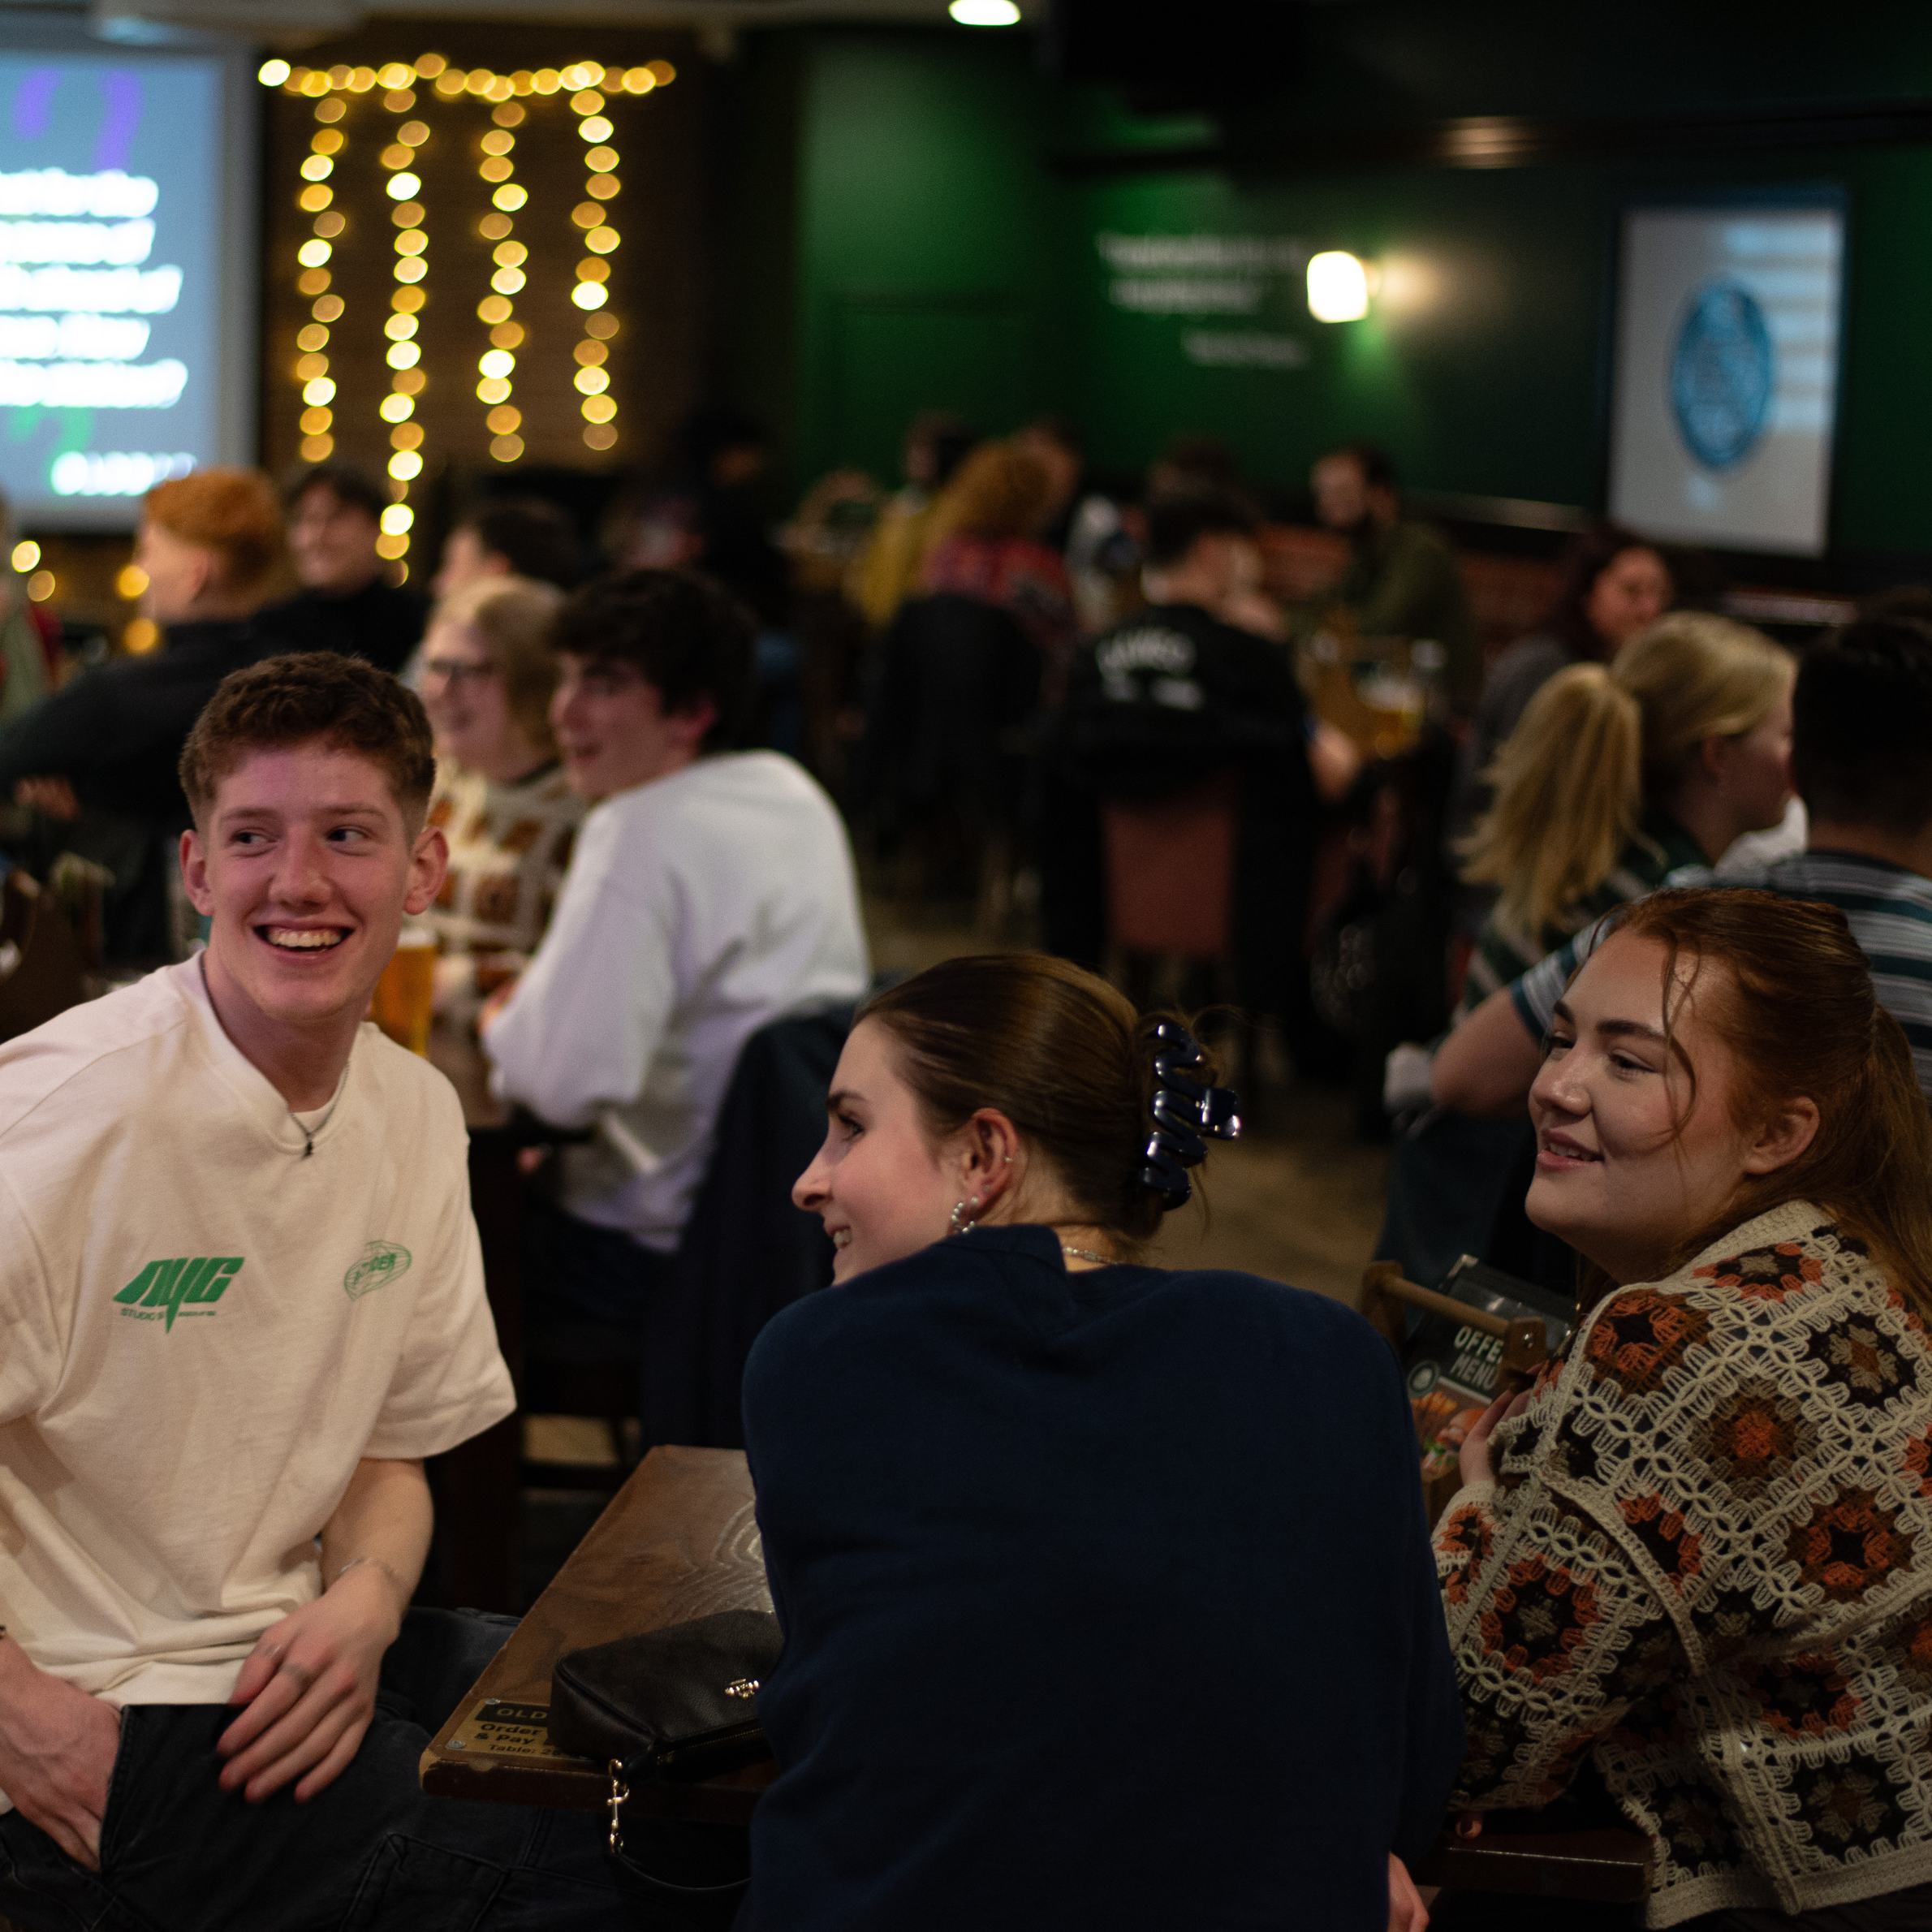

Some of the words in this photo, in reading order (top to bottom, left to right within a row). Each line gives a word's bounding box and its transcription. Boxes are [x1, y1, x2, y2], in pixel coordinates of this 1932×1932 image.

[1452, 1325, 1504, 1364] OFFE
[1449, 1352, 1500, 1391] MENU
[496, 1708, 549, 1719] OLD
[481, 1723, 543, 1735] Order
[496, 1734, 536, 1744] Pay
[489, 1744, 536, 1753] Table:
